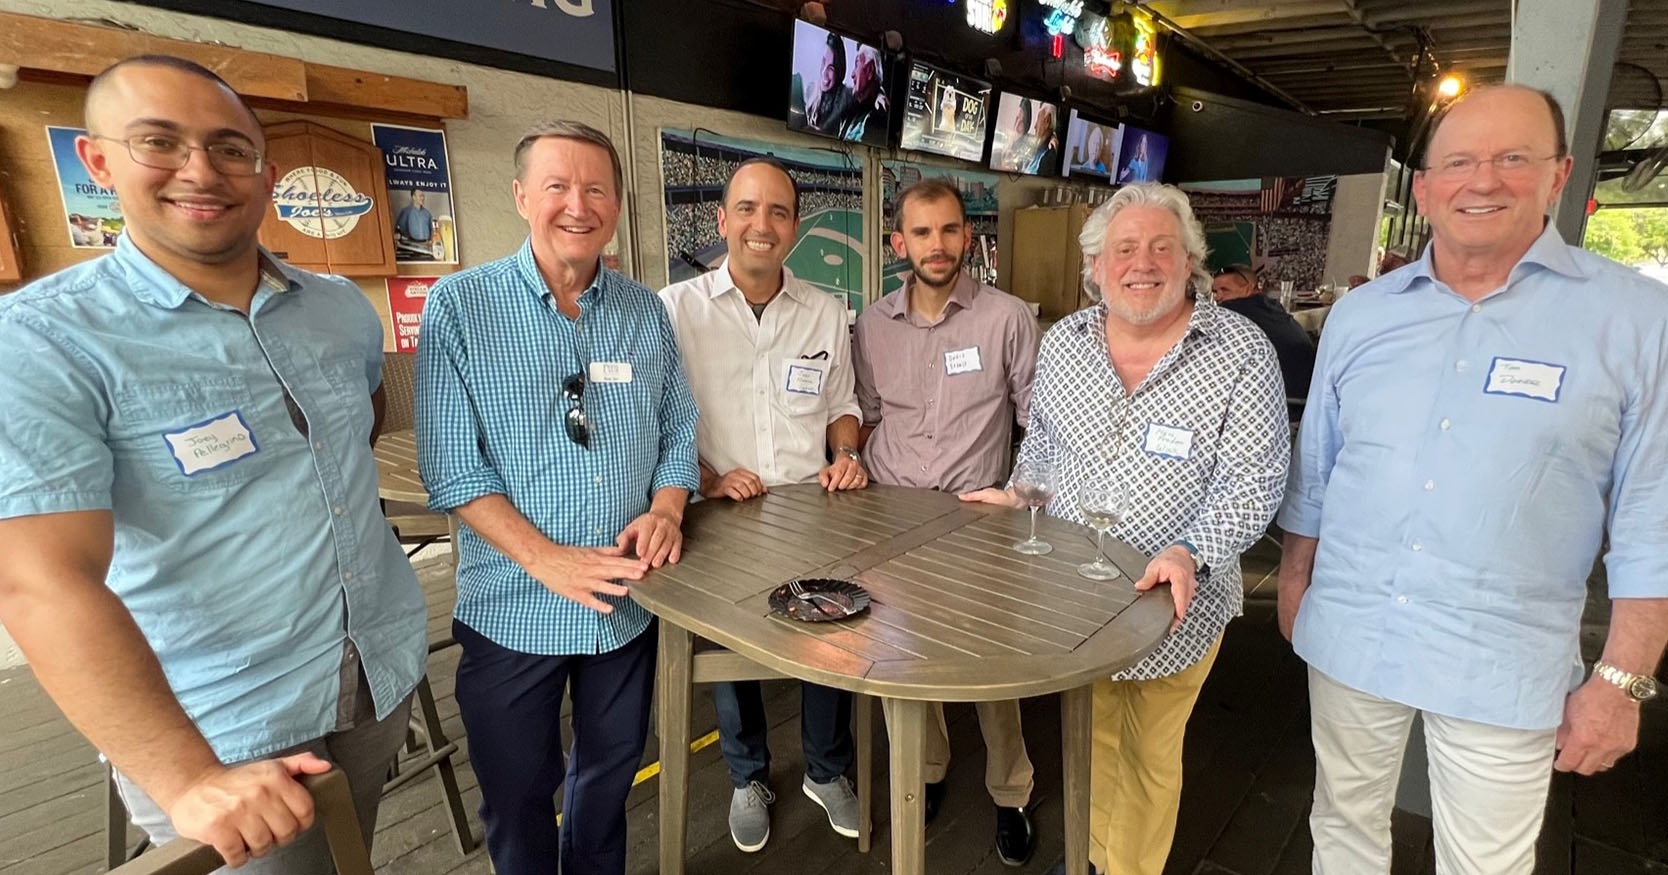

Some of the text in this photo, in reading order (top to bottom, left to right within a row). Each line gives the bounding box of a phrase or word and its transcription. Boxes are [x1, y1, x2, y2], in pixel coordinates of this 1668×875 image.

[962, 97, 978, 115] DOG
[386, 154, 438, 170] ULTRA
[75, 183, 98, 195] FOR
[416, 180, 437, 188] ENJOY
[183, 433, 219, 448] Joey
[193, 432, 247, 459] Pellegrino
